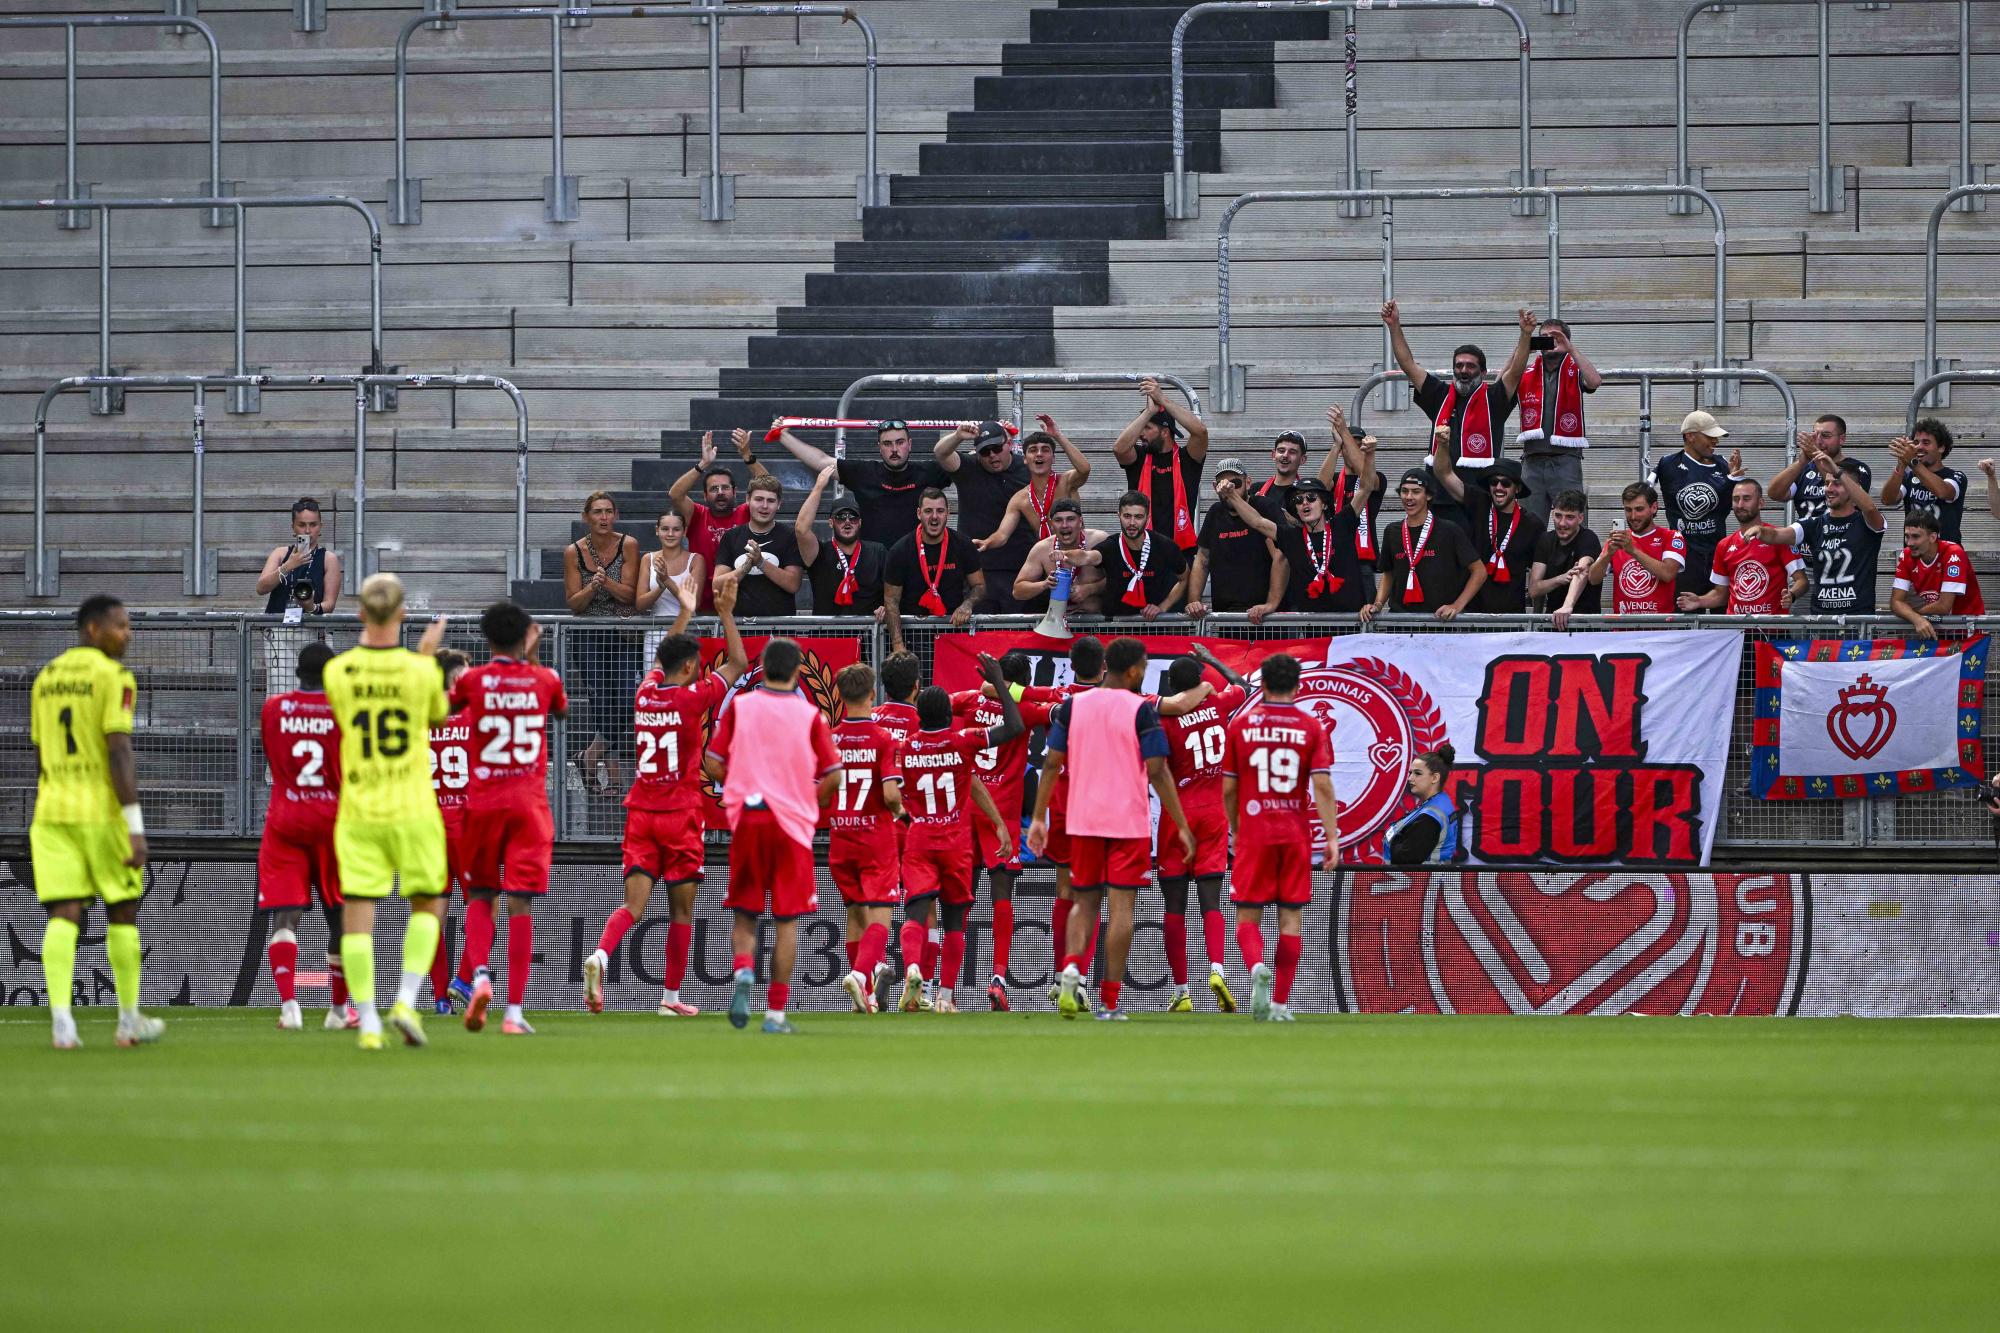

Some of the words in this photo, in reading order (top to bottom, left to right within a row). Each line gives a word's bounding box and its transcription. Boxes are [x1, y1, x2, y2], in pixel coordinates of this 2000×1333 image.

[1818, 548, 1855, 585] 22
[1626, 600, 1658, 611] VENDÉE
[1740, 602, 1772, 613] VENDÉE
[1818, 586, 1857, 599] AKENA
[1821, 600, 1851, 608] OUTDOOR
[484, 691, 539, 710] EVORA
[1306, 679, 1373, 704] YONNAIS
[1478, 654, 1649, 760] ON
[59, 706, 78, 755] 1
[280, 716, 335, 735] MAHOP
[352, 708, 410, 760] 16
[1177, 706, 1220, 729] NDIAYE
[1242, 726, 1307, 745] VILLETTE
[478, 714, 545, 764] 25
[637, 730, 679, 773] 21
[1185, 724, 1226, 770] 10
[292, 739, 325, 787] 2
[904, 751, 963, 769] BANGOURA
[1249, 747, 1300, 793] 19
[837, 768, 873, 811] 17
[916, 772, 957, 815] 11
[837, 815, 877, 828] DURET
[1444, 765, 1702, 862] TOUR
